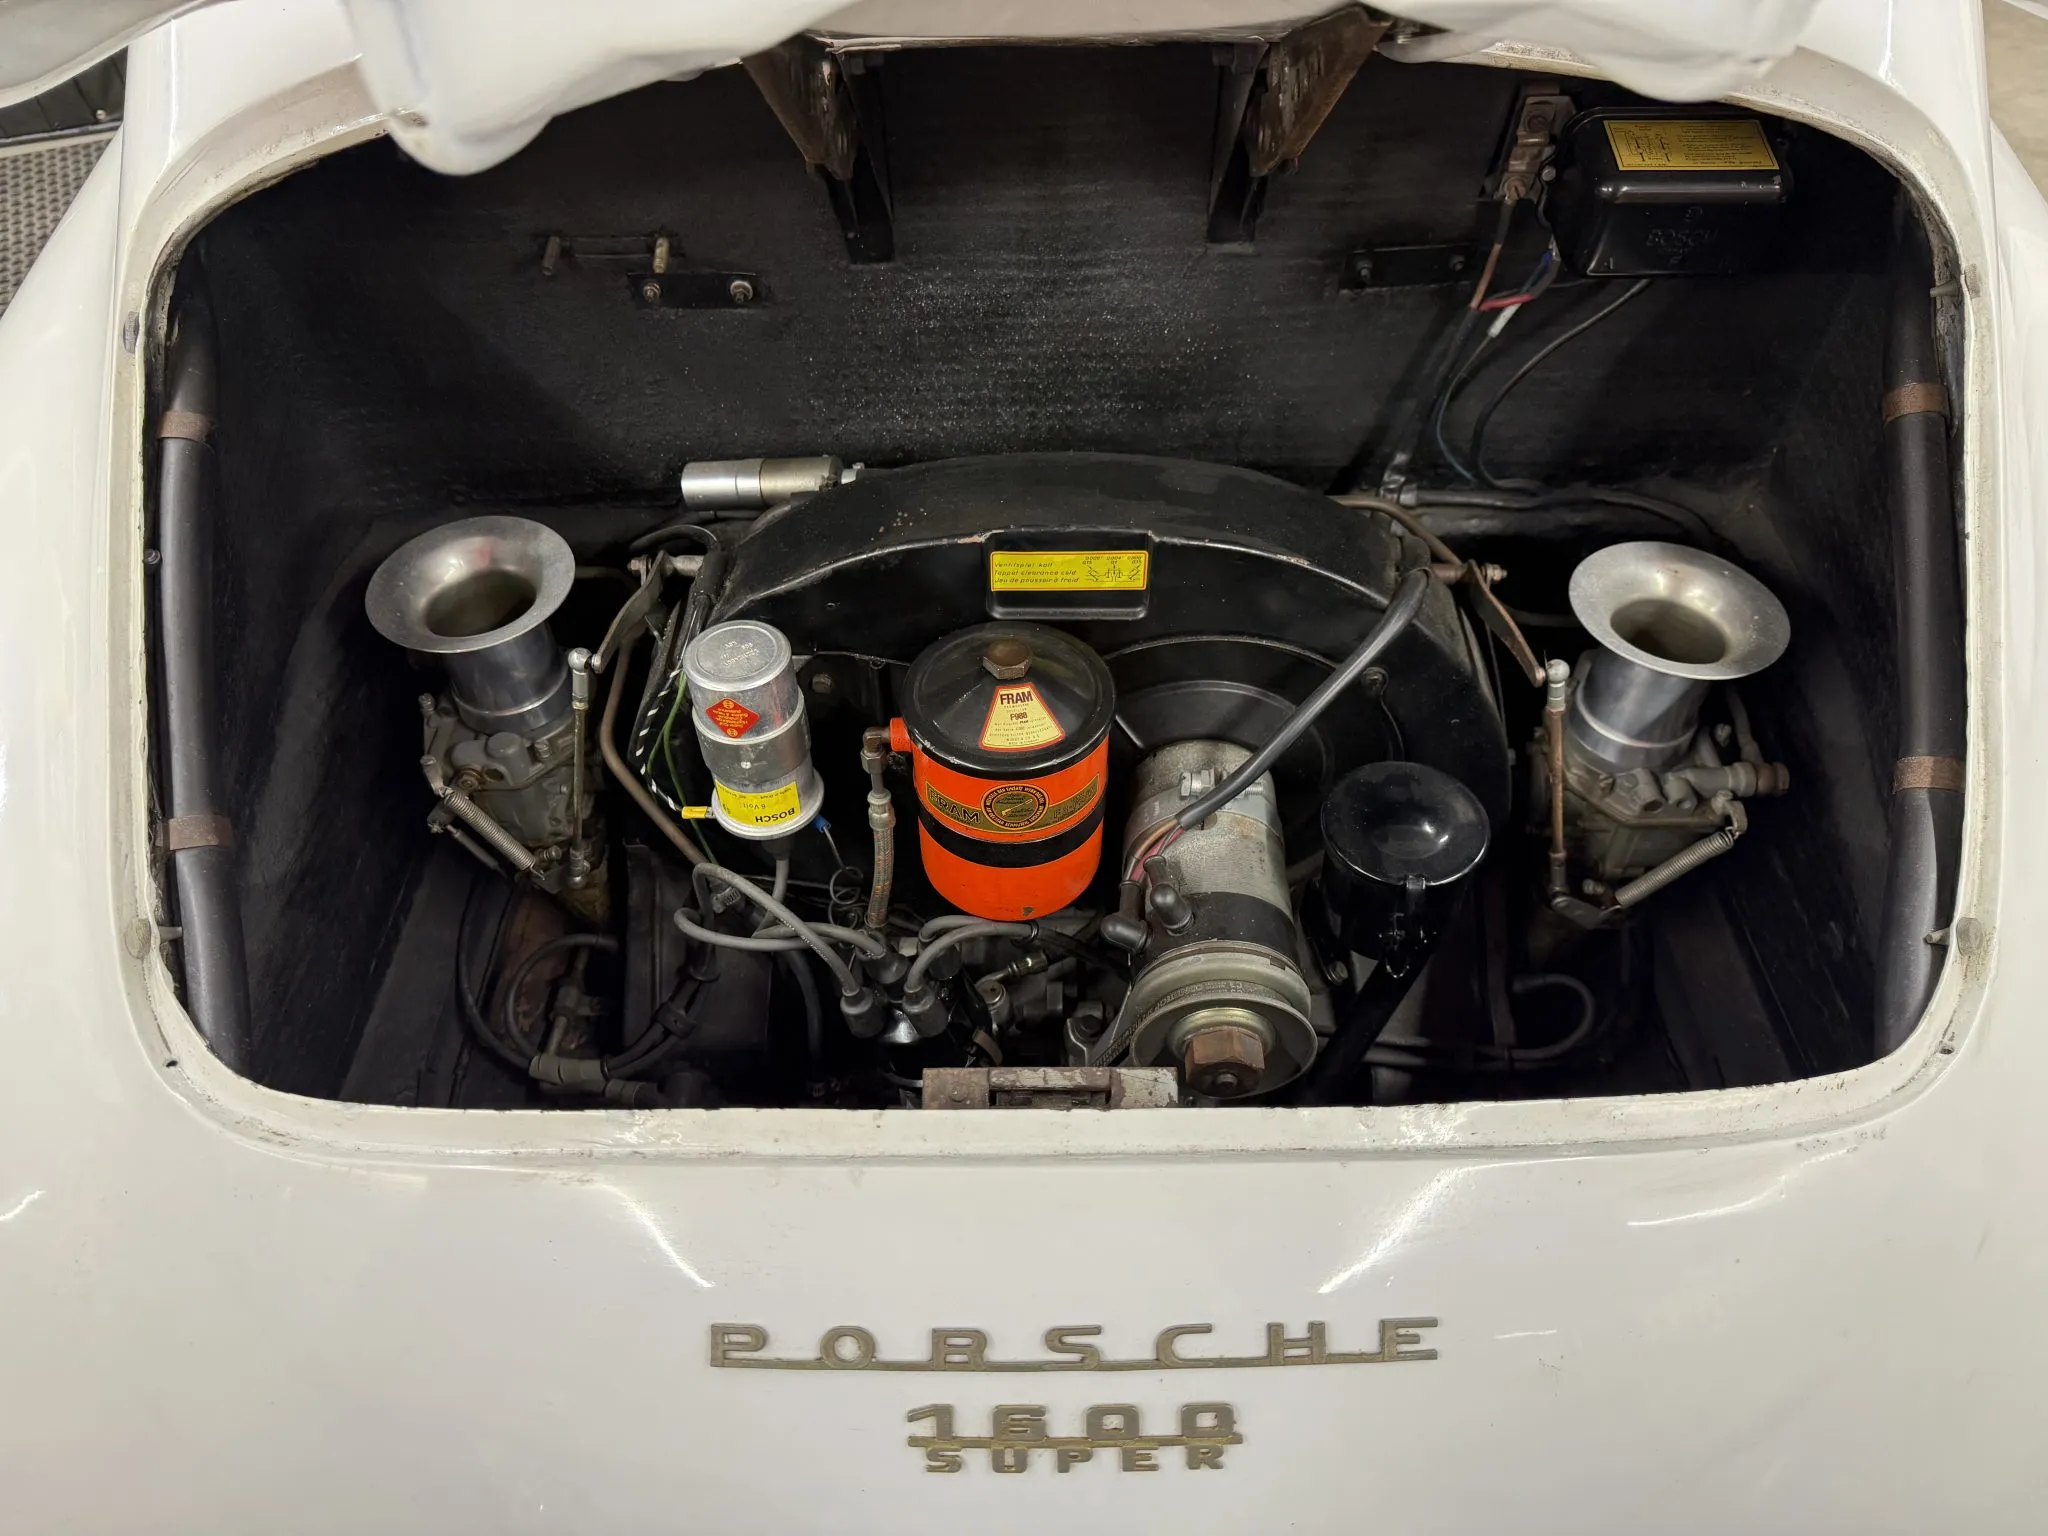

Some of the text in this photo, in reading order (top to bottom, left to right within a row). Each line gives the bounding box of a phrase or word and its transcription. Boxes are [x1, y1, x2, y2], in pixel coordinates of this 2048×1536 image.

[1000, 691, 1034, 705] FRAM
[755, 807, 795, 823] BOSCH
[929, 788, 980, 823] FRAM
[711, 1317, 1438, 1372] PORSCHE
[907, 1403, 1236, 1442] 1600
[926, 1445, 1224, 1473] SUPER
